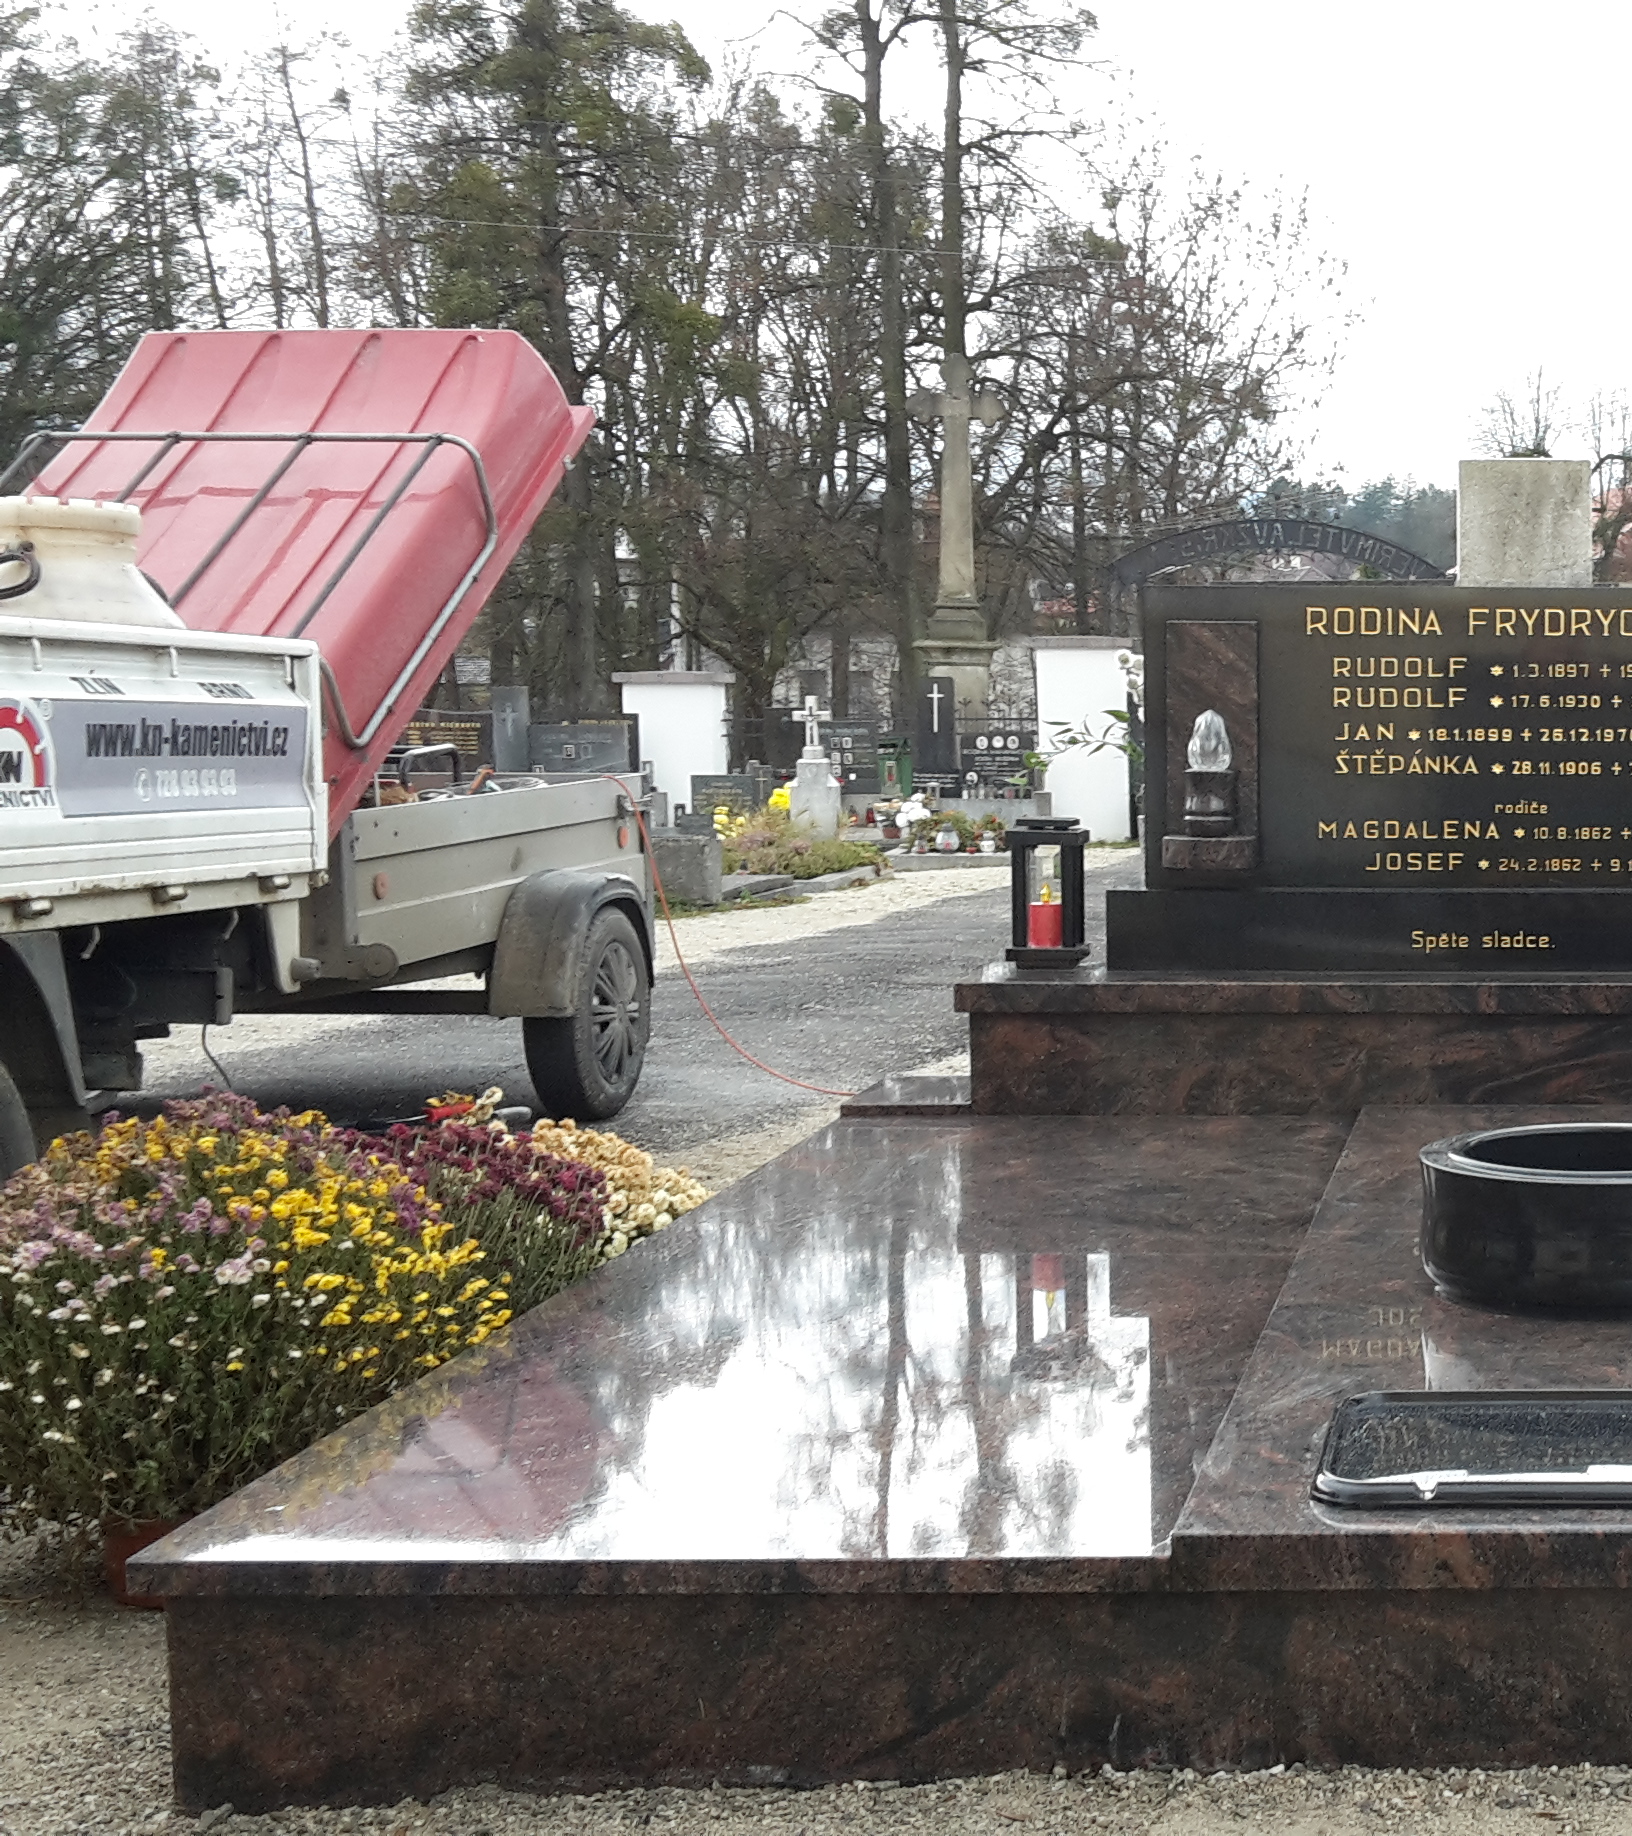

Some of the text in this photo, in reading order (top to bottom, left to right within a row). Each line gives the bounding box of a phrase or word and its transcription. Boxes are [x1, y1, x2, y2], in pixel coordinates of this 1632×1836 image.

[1305, 607, 1443, 636] RODINA
[1332, 657, 1467, 678] RUDOLF
[1332, 687, 1467, 708] RUDOLF
[85, 717, 289, 757] www.kn-kamenictvi.cz
[1335, 723, 1394, 742] JAN
[1335, 749, 1479, 775] ŠTĚPÁNKA
[1494, 800, 1549, 815] rodiče
[1318, 821, 1500, 840] MAGDALENA
[1365, 853, 1465, 871] JOSEF
[1411, 931, 1556, 954] Spěte sladce.
